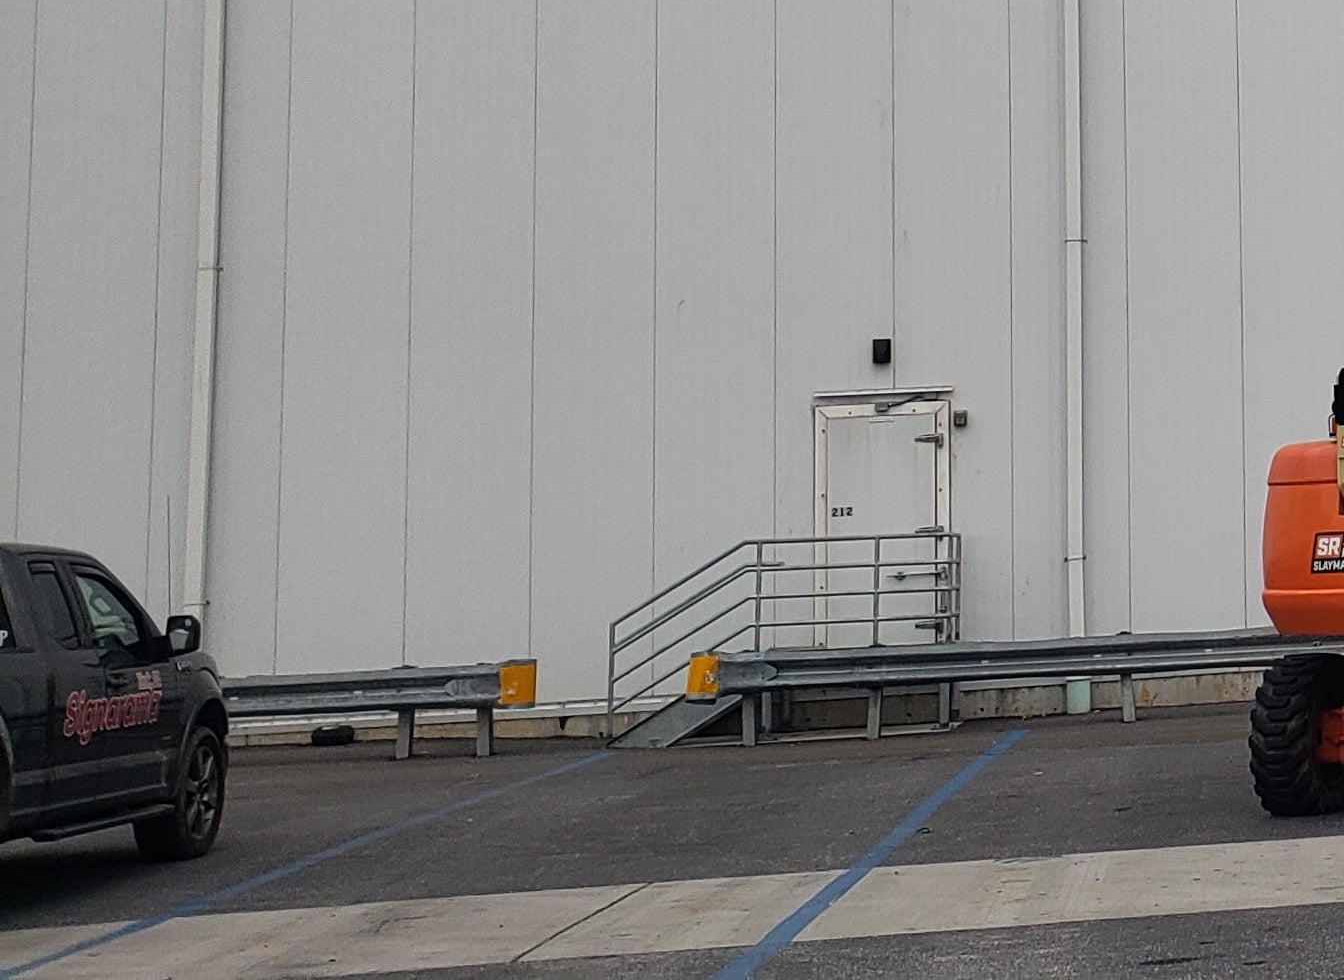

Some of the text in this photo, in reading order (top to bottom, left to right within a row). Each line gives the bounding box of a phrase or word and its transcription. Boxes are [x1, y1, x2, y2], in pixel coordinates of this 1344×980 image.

[831, 507, 853, 518] 212
[1316, 536, 1341, 557] SR
[63, 689, 162, 746] Signarama
